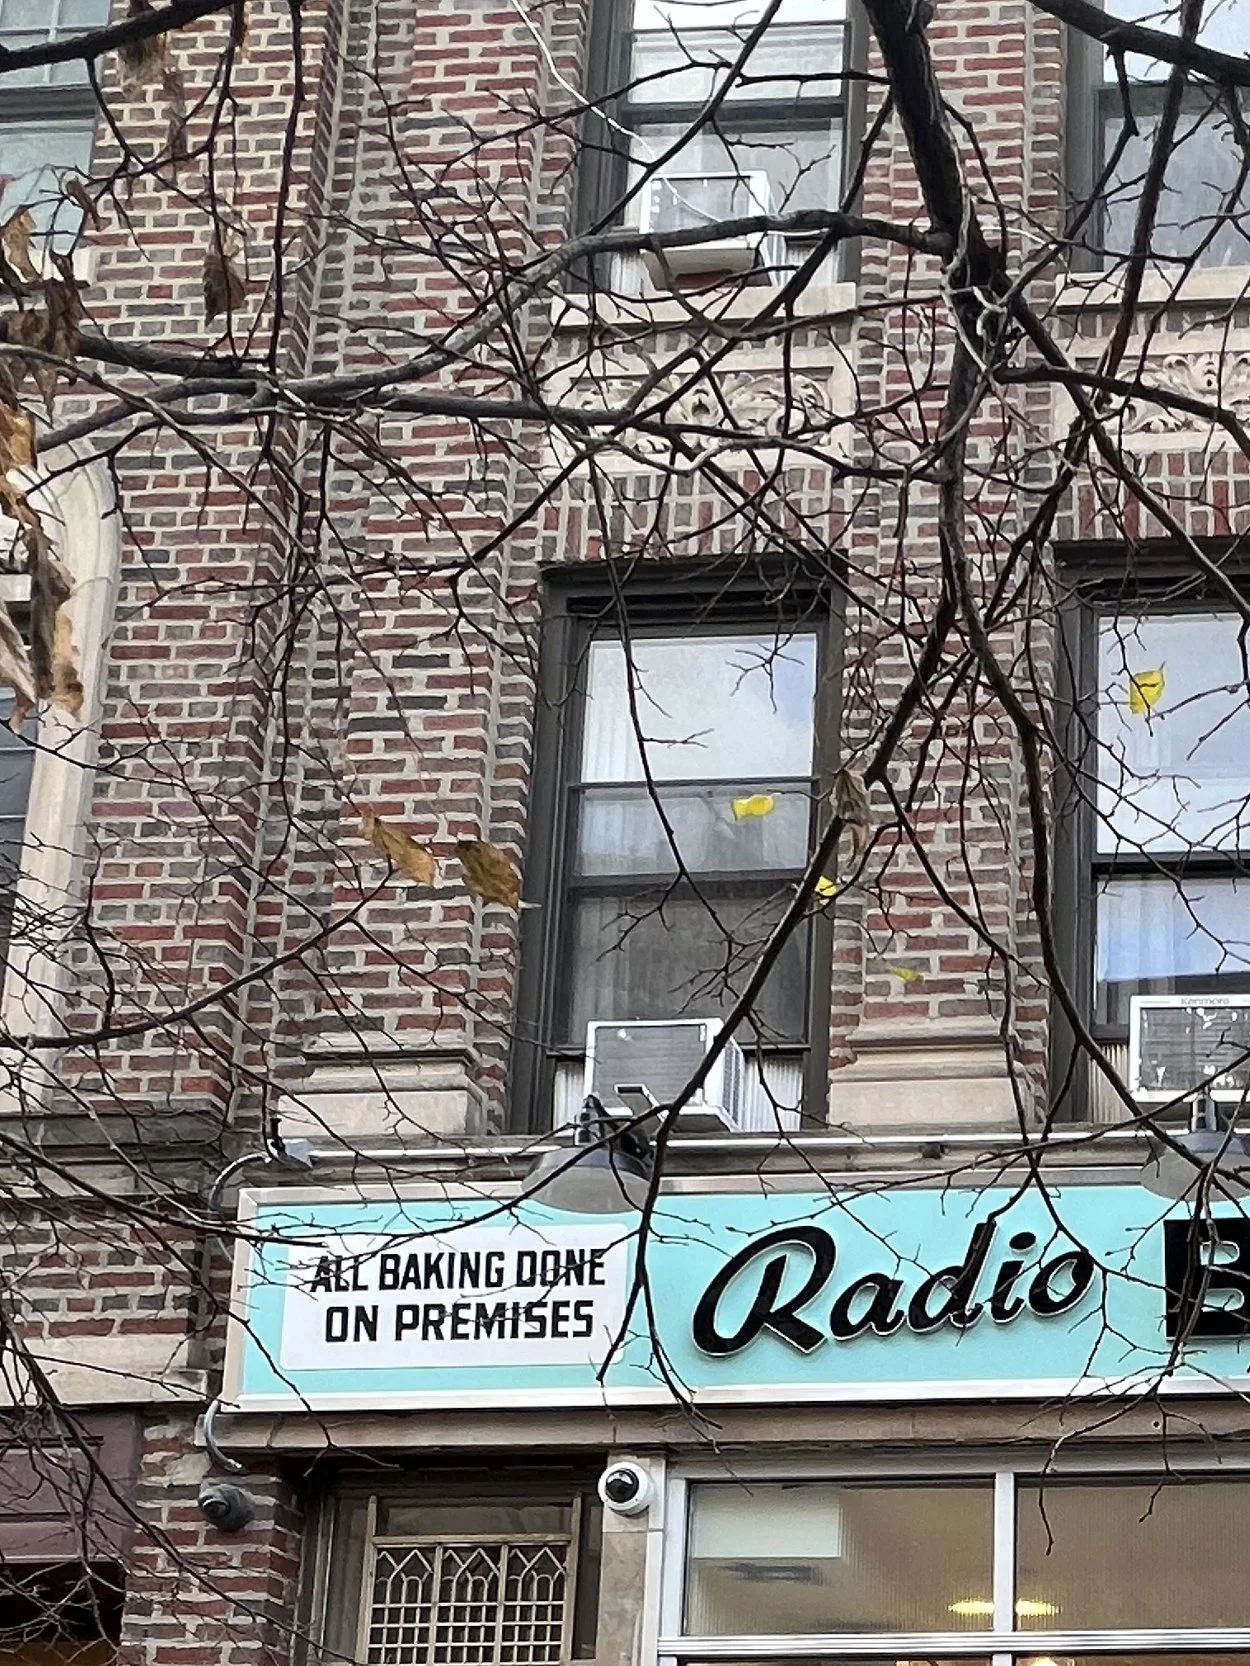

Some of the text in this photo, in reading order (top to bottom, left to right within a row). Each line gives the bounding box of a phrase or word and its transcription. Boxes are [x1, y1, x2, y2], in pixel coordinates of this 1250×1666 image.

[310, 1248, 605, 1292] ALL BAKING DONE
[693, 1225, 1096, 1358] Radio
[325, 1300, 594, 1342] ON PREMISES
